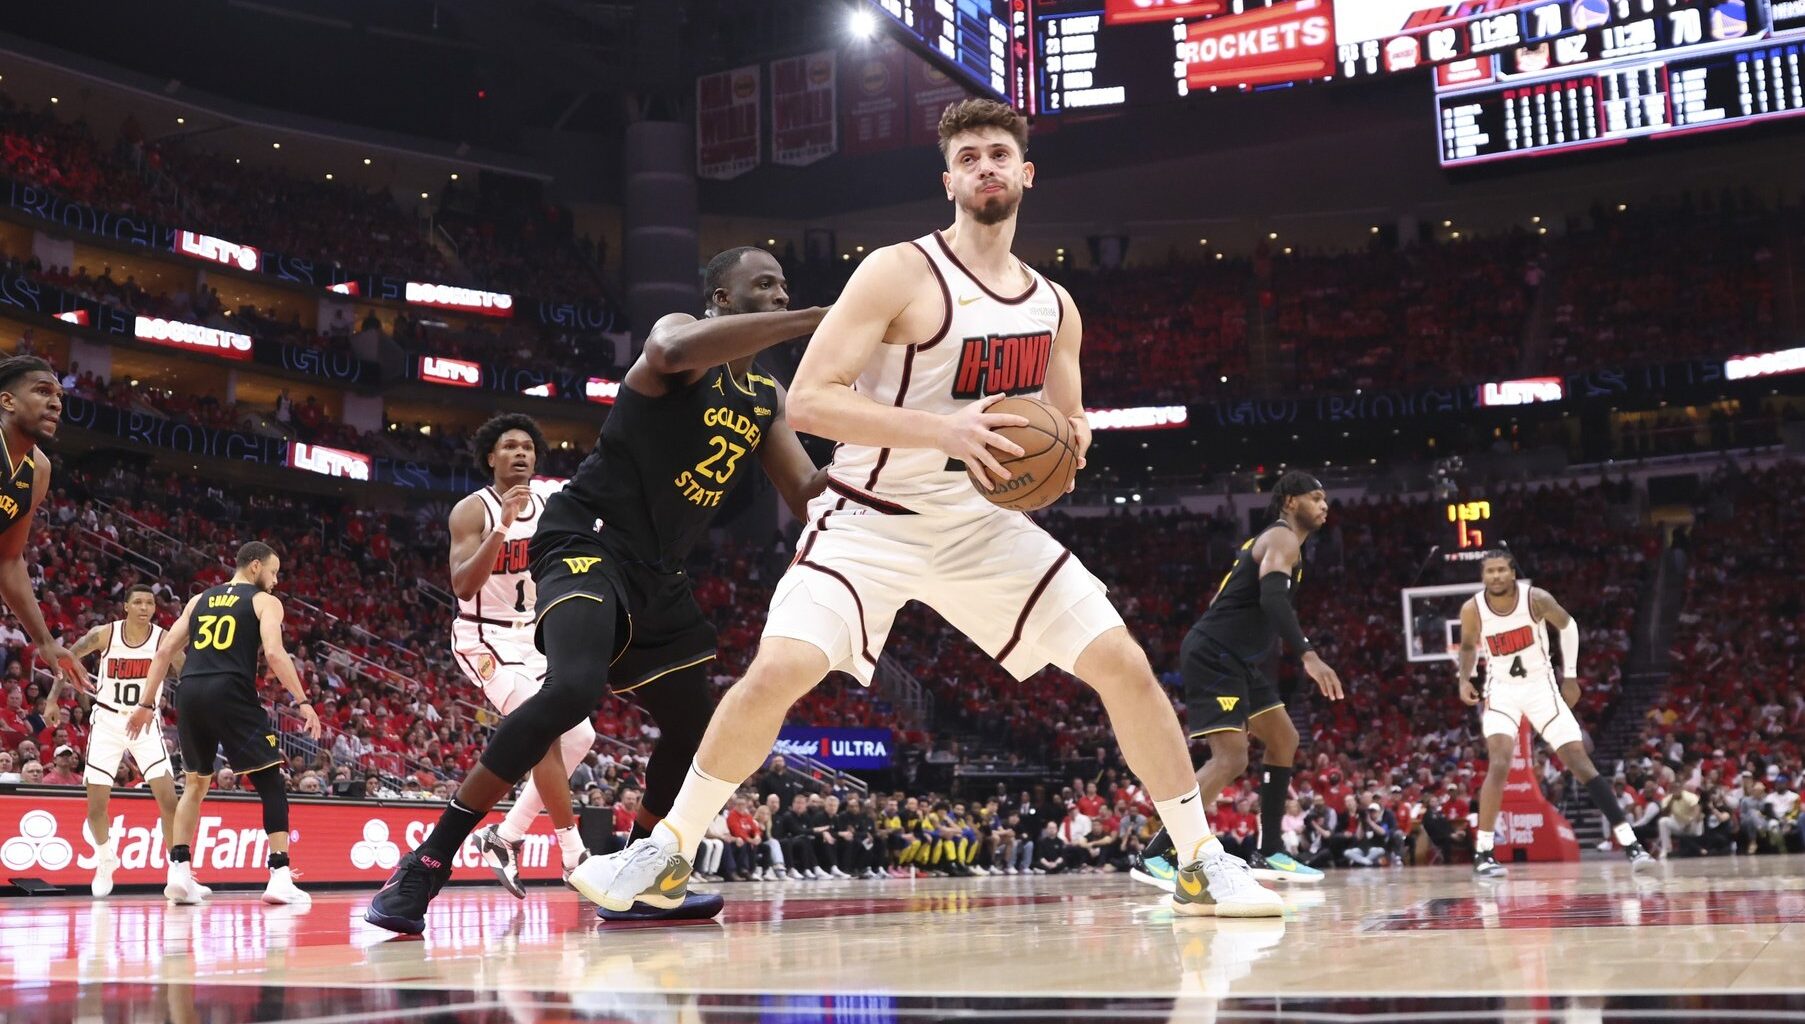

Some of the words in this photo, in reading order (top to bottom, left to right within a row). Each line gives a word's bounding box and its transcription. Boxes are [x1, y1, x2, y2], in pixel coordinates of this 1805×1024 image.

[1184, 16, 1329, 63] ROCKETS
[406, 281, 512, 309] ROCKETS
[135, 316, 251, 350] ROCKETS
[695, 435, 746, 484] 23
[674, 470, 724, 507] STATE
[208, 595, 240, 609] CURRY
[514, 579, 526, 612] 1
[194, 614, 236, 650] 30
[1509, 655, 1528, 678] 4
[114, 682, 140, 706] 10
[832, 740, 886, 756] ULTRA
